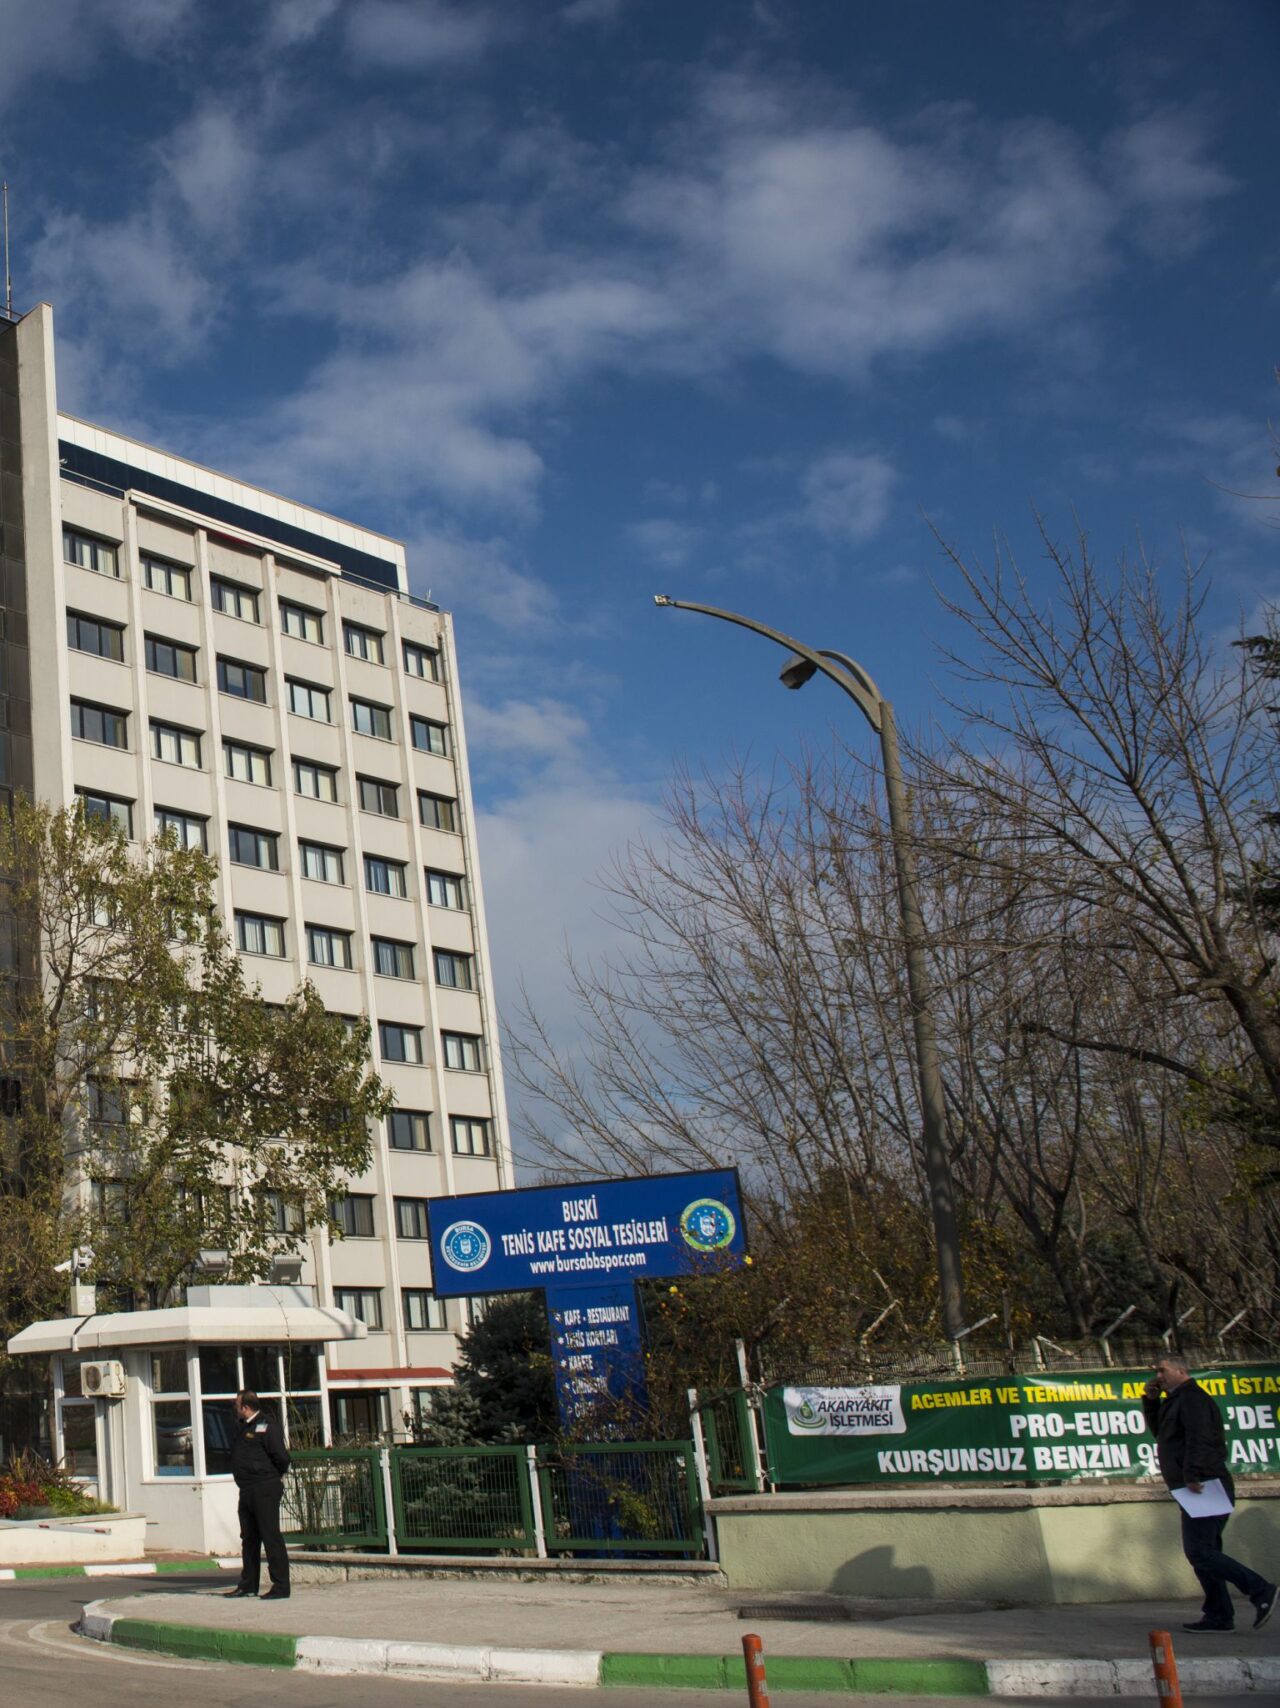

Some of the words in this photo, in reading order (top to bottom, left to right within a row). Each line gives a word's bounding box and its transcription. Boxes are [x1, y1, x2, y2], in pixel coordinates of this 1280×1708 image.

[562, 1194, 598, 1223] BUSKİ
[501, 1228, 535, 1256] TENİS
[536, 1229, 567, 1253] KAFE
[568, 1225, 613, 1251] SOSYAL
[612, 1216, 669, 1246] TESİSLERİ
[563, 1308, 581, 1326] KAFE
[586, 1306, 630, 1324] RESTAURANT
[564, 1329, 585, 1347] TNİS
[817, 1399, 893, 1413] AKARYAKIT
[911, 1386, 993, 1410] ACEMLER
[995, 1387, 1020, 1405] VE
[1023, 1380, 1118, 1403] TERMİNAL
[829, 1411, 894, 1429] İŞLETMESİ
[1009, 1410, 1147, 1438] PRO-EURO
[877, 1447, 1027, 1476] KURŞUNSUZ
[1033, 1438, 1131, 1471] BENZİN
